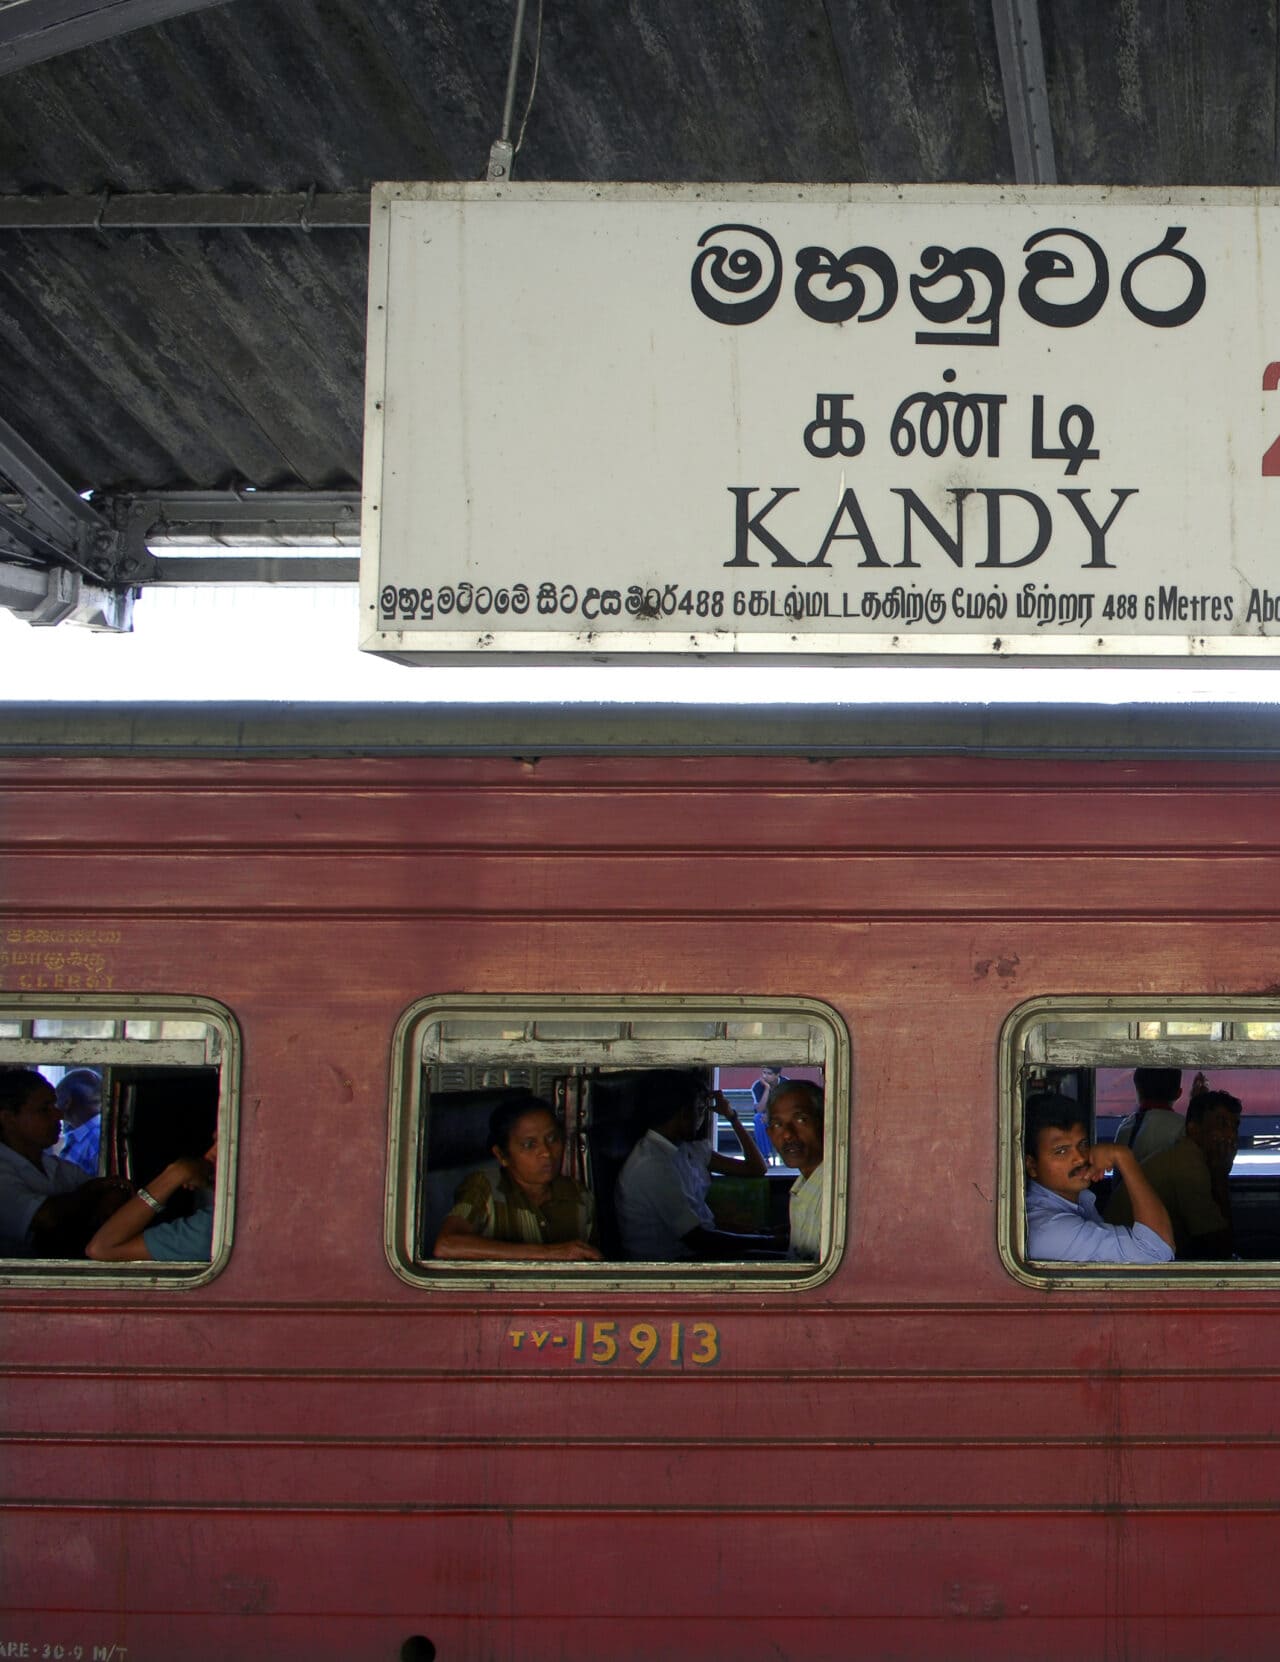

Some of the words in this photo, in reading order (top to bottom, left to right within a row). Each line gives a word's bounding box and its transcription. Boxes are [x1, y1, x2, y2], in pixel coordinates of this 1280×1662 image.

[691, 224, 1206, 346] මහනුවර
[804, 369, 1100, 475] கண்டி
[723, 487, 1139, 568] KANDY
[679, 591, 724, 617] 488
[952, 584, 1007, 619] மேல்
[1102, 595, 1138, 620] 488
[1159, 586, 1234, 621] Metres
